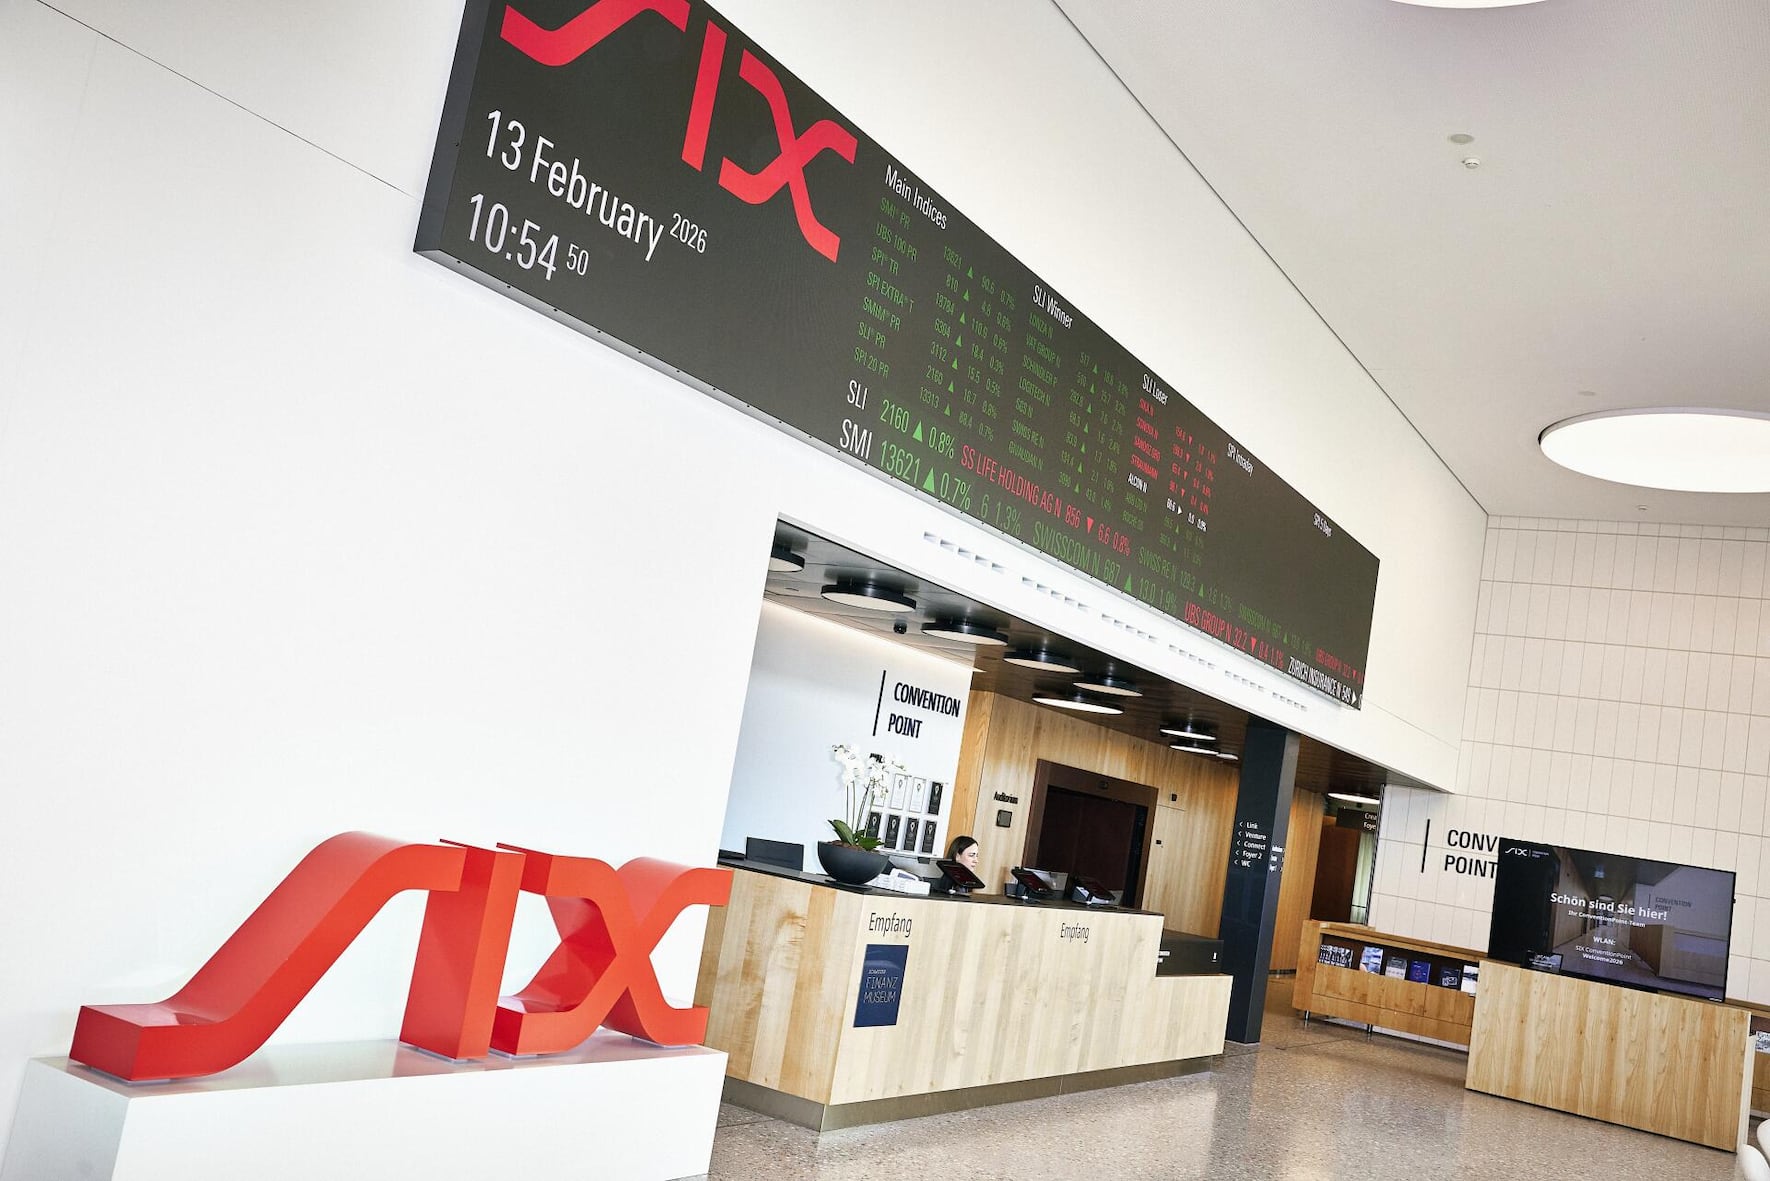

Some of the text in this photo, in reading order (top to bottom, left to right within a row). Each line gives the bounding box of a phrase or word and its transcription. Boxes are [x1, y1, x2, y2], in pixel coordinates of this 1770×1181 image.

[484, 110, 709, 263] 13 February 2026
[885, 163, 947, 230] Main Indices
[467, 193, 590, 282] 10:54 50
[1032, 283, 1073, 330] SLI Winner
[875, 331, 886, 350] PR
[930, 340, 947, 363] 3112
[853, 345, 867, 366] SPI
[867, 354, 878, 373] 20
[878, 361, 889, 379] PR
[1142, 372, 1152, 394] SLI
[1152, 380, 1168, 406] Loser
[847, 379, 956, 460] SLI 2160 0.8%
[839, 418, 972, 511] SMI 13621 0.7%
[960, 443, 975, 470] SS
[976, 452, 997, 482] LIFE
[997, 464, 1039, 506] HOLDING
[1039, 488, 1053, 513] AG
[1053, 496, 1062, 518] N
[1064, 503, 1081, 529] 856
[1097, 521, 1110, 545] 6.6
[1138, 545, 1161, 573] SWISS
[1160, 558, 1170, 578] RE
[994, 499, 1021, 536] 1.3%
[1032, 519, 1090, 570] SWISSCOM
[1090, 550, 1100, 575] N
[1102, 556, 1120, 586] 687
[1138, 575, 1155, 603] 13.0
[1183, 599, 1200, 626] UBS
[1200, 608, 1225, 638] GROUP
[1224, 621, 1232, 642] N
[1288, 654, 1309, 680] ZURICH
[1308, 665, 1337, 695] INSURANCE
[894, 682, 961, 718] CONVENTION
[888, 713, 923, 738] POINT
[1246, 821, 1259, 830] Link
[1447, 829, 1498, 852] CONV
[1240, 859, 1251, 868] WC
[1242, 850, 1258, 860] Foyer
[1444, 854, 1498, 879] POINT
[1550, 892, 1667, 920] Schön sind Sie hier!
[868, 912, 912, 938] Empfang
[1060, 922, 1090, 943] Empfang
[69, 831, 732, 1082] SIX
[1585, 946, 1632, 960] ConventionPoint
[866, 976, 899, 989] FINANZ
[863, 991, 896, 1004] MUSEUM
